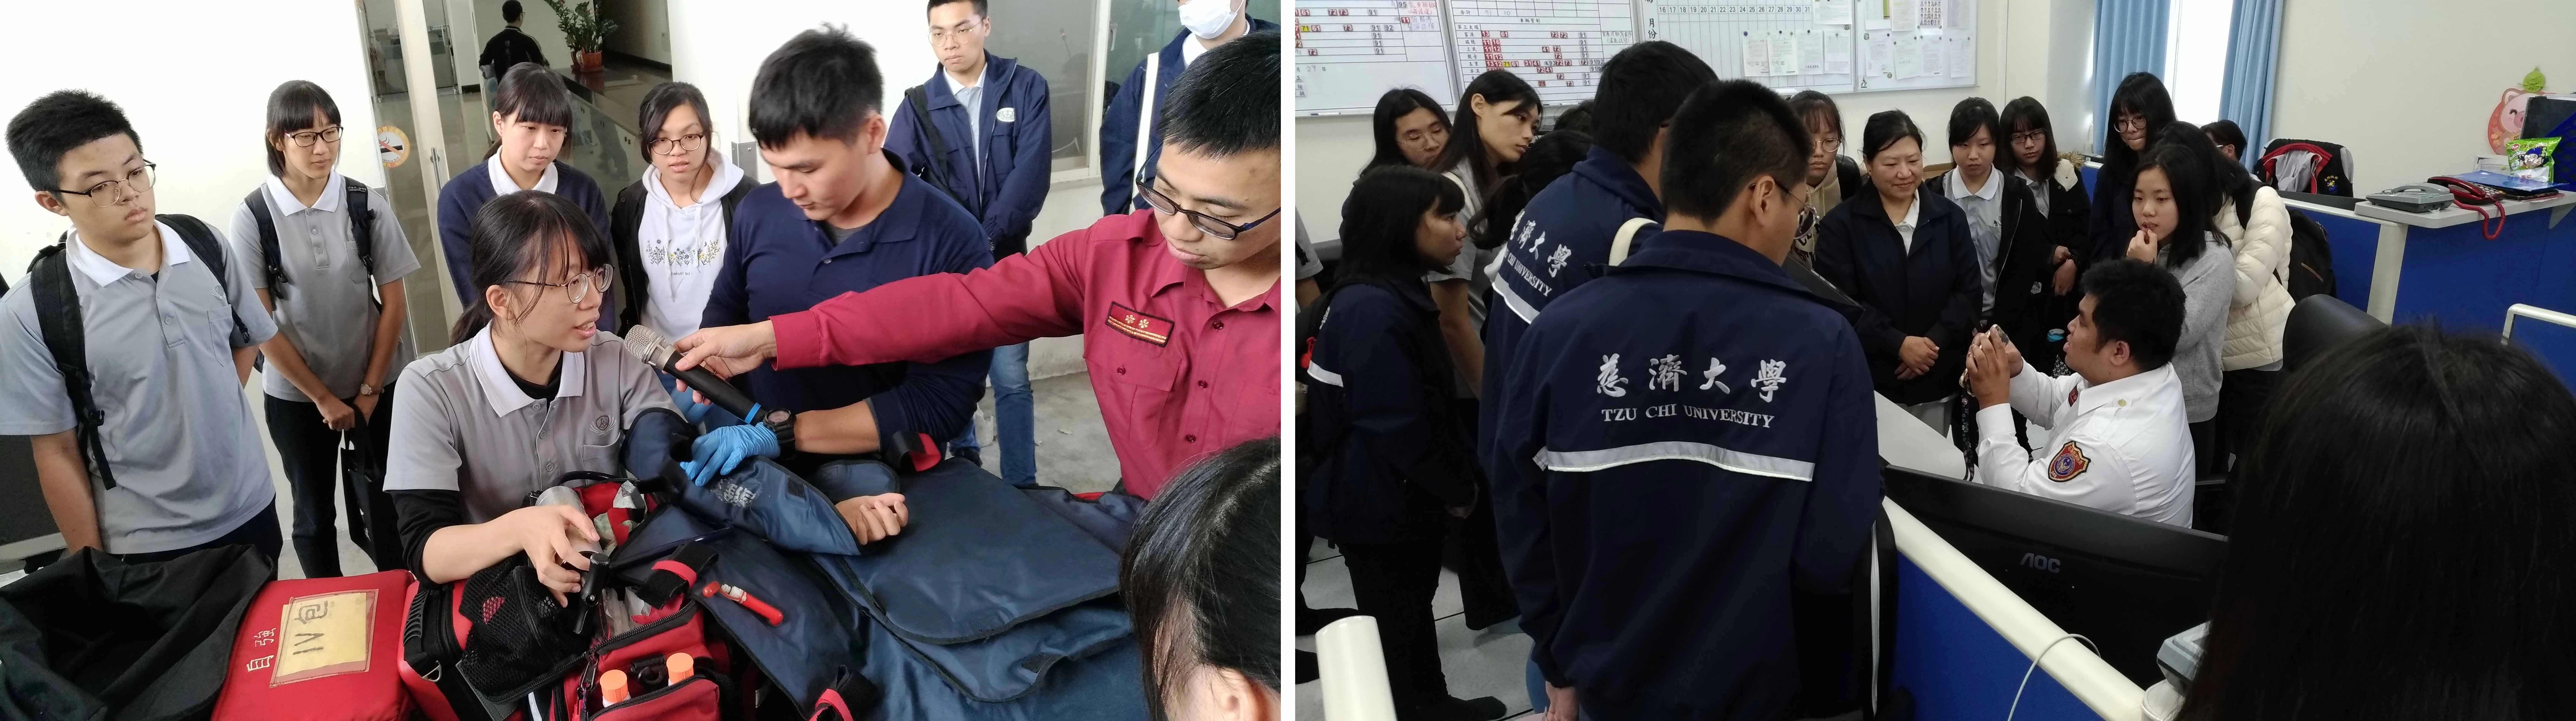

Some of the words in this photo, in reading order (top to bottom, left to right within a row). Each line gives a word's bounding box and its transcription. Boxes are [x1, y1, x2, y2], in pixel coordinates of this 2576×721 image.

[1648, 18, 1657, 39] 月份
[1508, 253, 1516, 266] CHI
[1515, 259, 1552, 297] UNIVERSITY
[1597, 353, 1786, 402] 慈濟大學
[1601, 408, 1637, 423] TZU
[1646, 404, 1677, 418] CHI
[1684, 405, 1775, 428] UNIVERSITY
[2020, 553, 2060, 573] AOC
